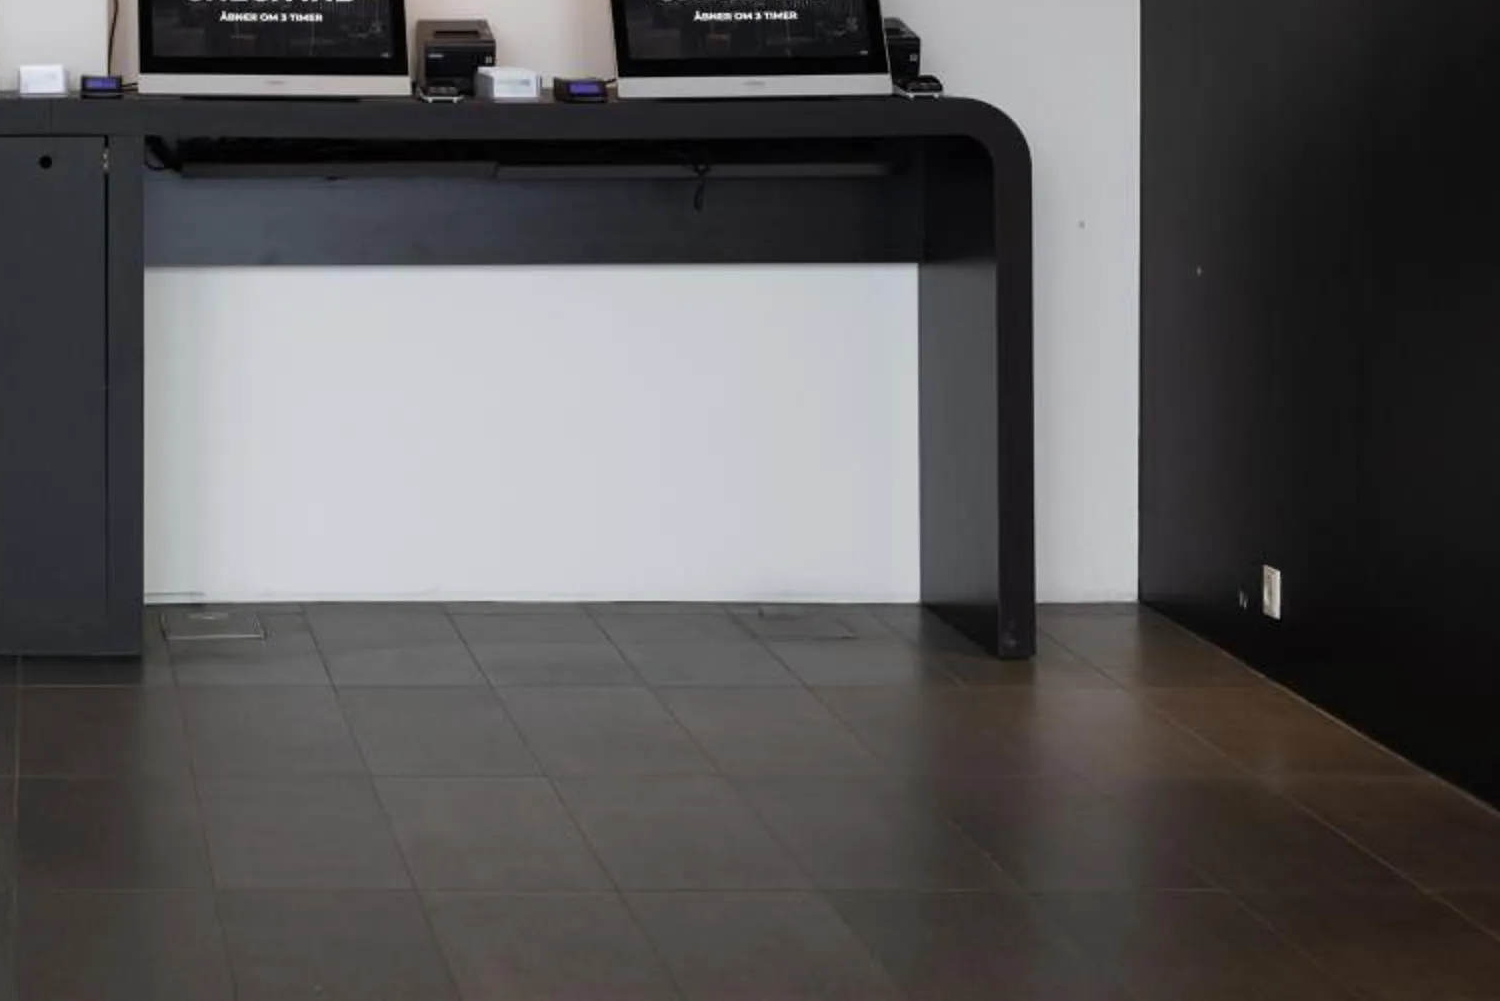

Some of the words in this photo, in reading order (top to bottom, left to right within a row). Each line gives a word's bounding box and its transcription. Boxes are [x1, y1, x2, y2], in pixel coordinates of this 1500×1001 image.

[259, 12, 279, 22] OM
[290, 12, 323, 22] TIMER
[733, 12, 753, 21] OM
[764, 10, 798, 21] TIMER
